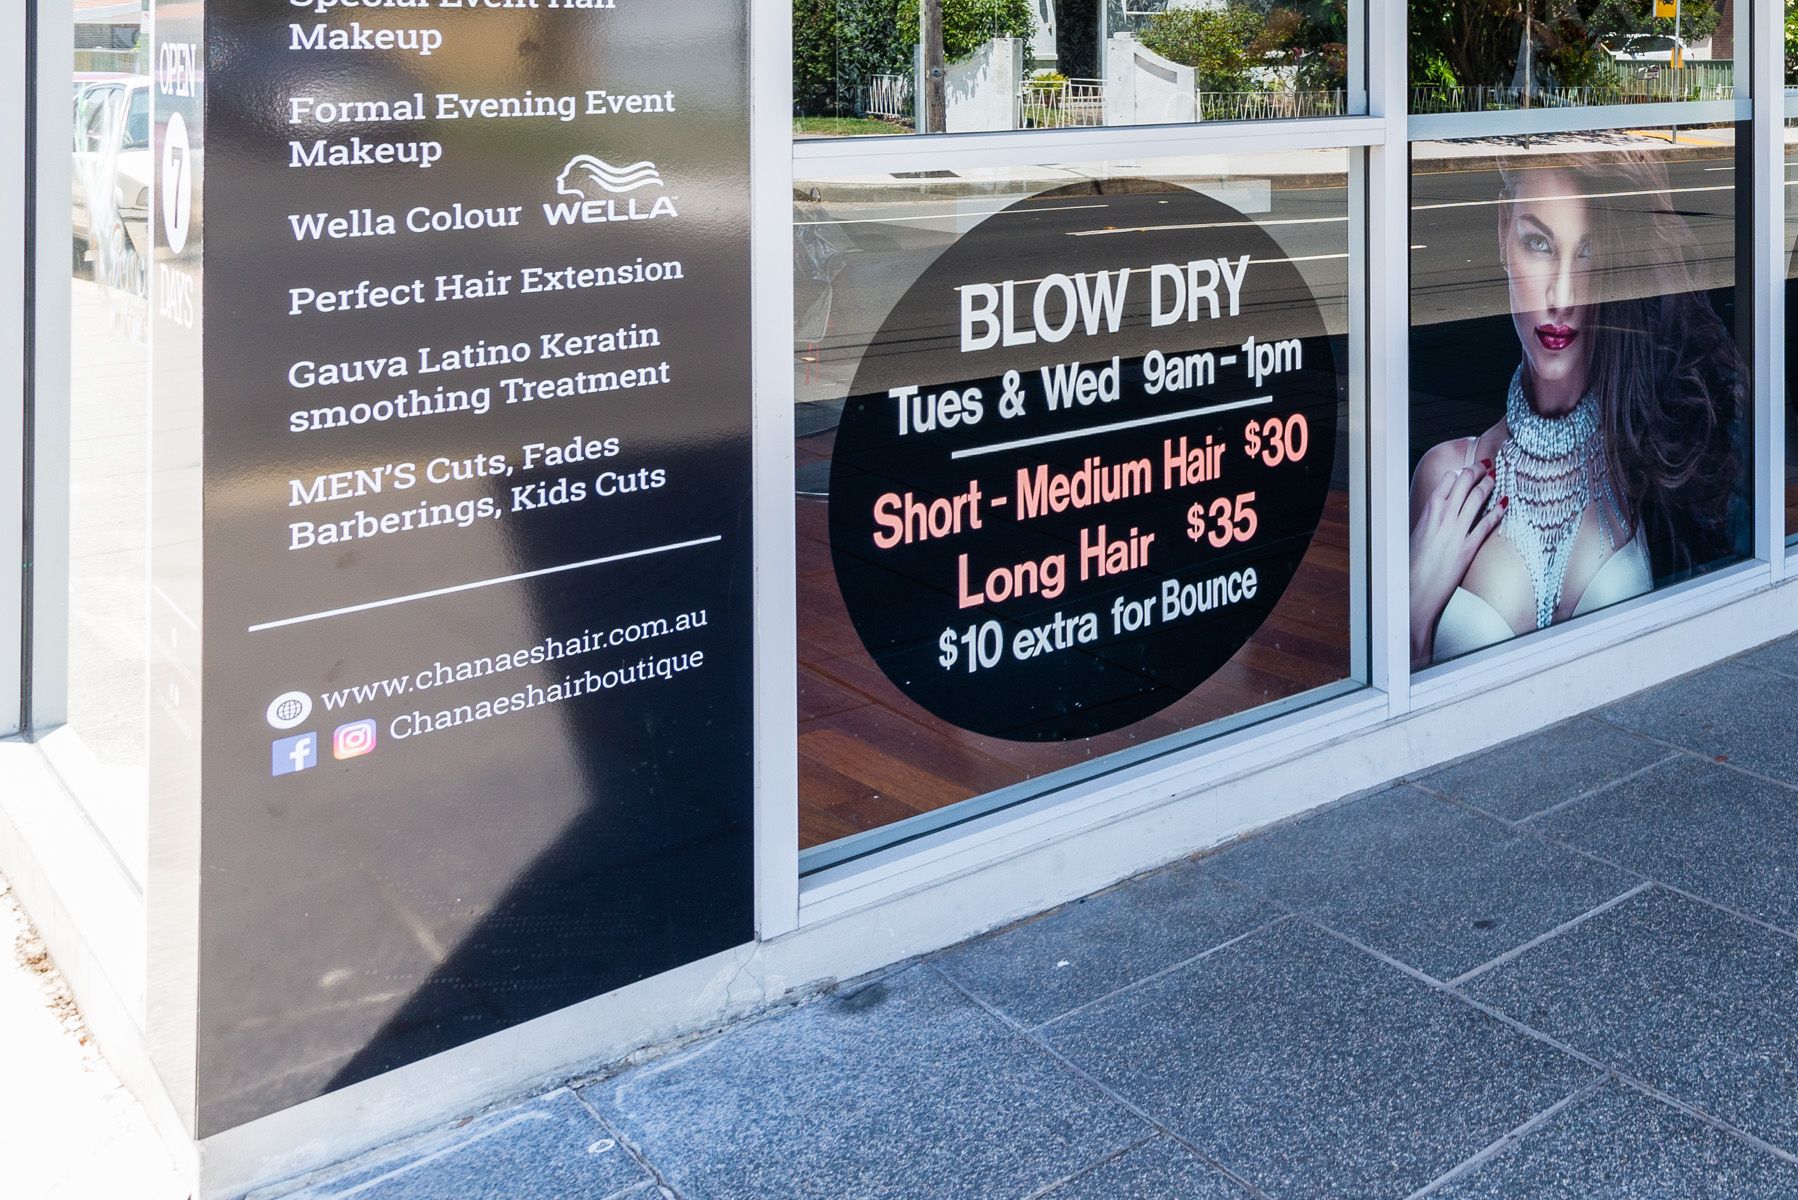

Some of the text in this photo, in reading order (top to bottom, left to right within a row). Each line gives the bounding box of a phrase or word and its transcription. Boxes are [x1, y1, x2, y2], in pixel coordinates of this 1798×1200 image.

[160, 42, 197, 98] OPEN
[289, 22, 443, 56] Makeup
[289, 88, 676, 124] Formal Evening Event
[171, 146, 183, 229] 7
[289, 136, 443, 169] Makeup
[288, 201, 522, 241] Wella Colour
[542, 195, 680, 226] WELLA
[160, 262, 194, 331] DAYS
[289, 257, 685, 316] Perfect Hair Extension
[958, 254, 1252, 354] BLOW DRY
[288, 323, 661, 389] Gauva Latino Keratin
[289, 360, 672, 433] smoothing Treatment
[888, 384, 984, 437] Tues
[998, 370, 1027, 420] &
[1040, 356, 1121, 413] Wed
[289, 436, 621, 507] MEN'S Cuts, Fades
[289, 464, 667, 551] Barberings, Kids Cuts
[872, 412, 1309, 552] Short Medium Hair $30
[958, 490, 1259, 610] Long Hair $35
[938, 566, 1259, 675] $10 extra for Bounce
[321, 608, 709, 712] www.chanaeshair.com.au
[389, 648, 705, 741] Chanaeshairboutique
